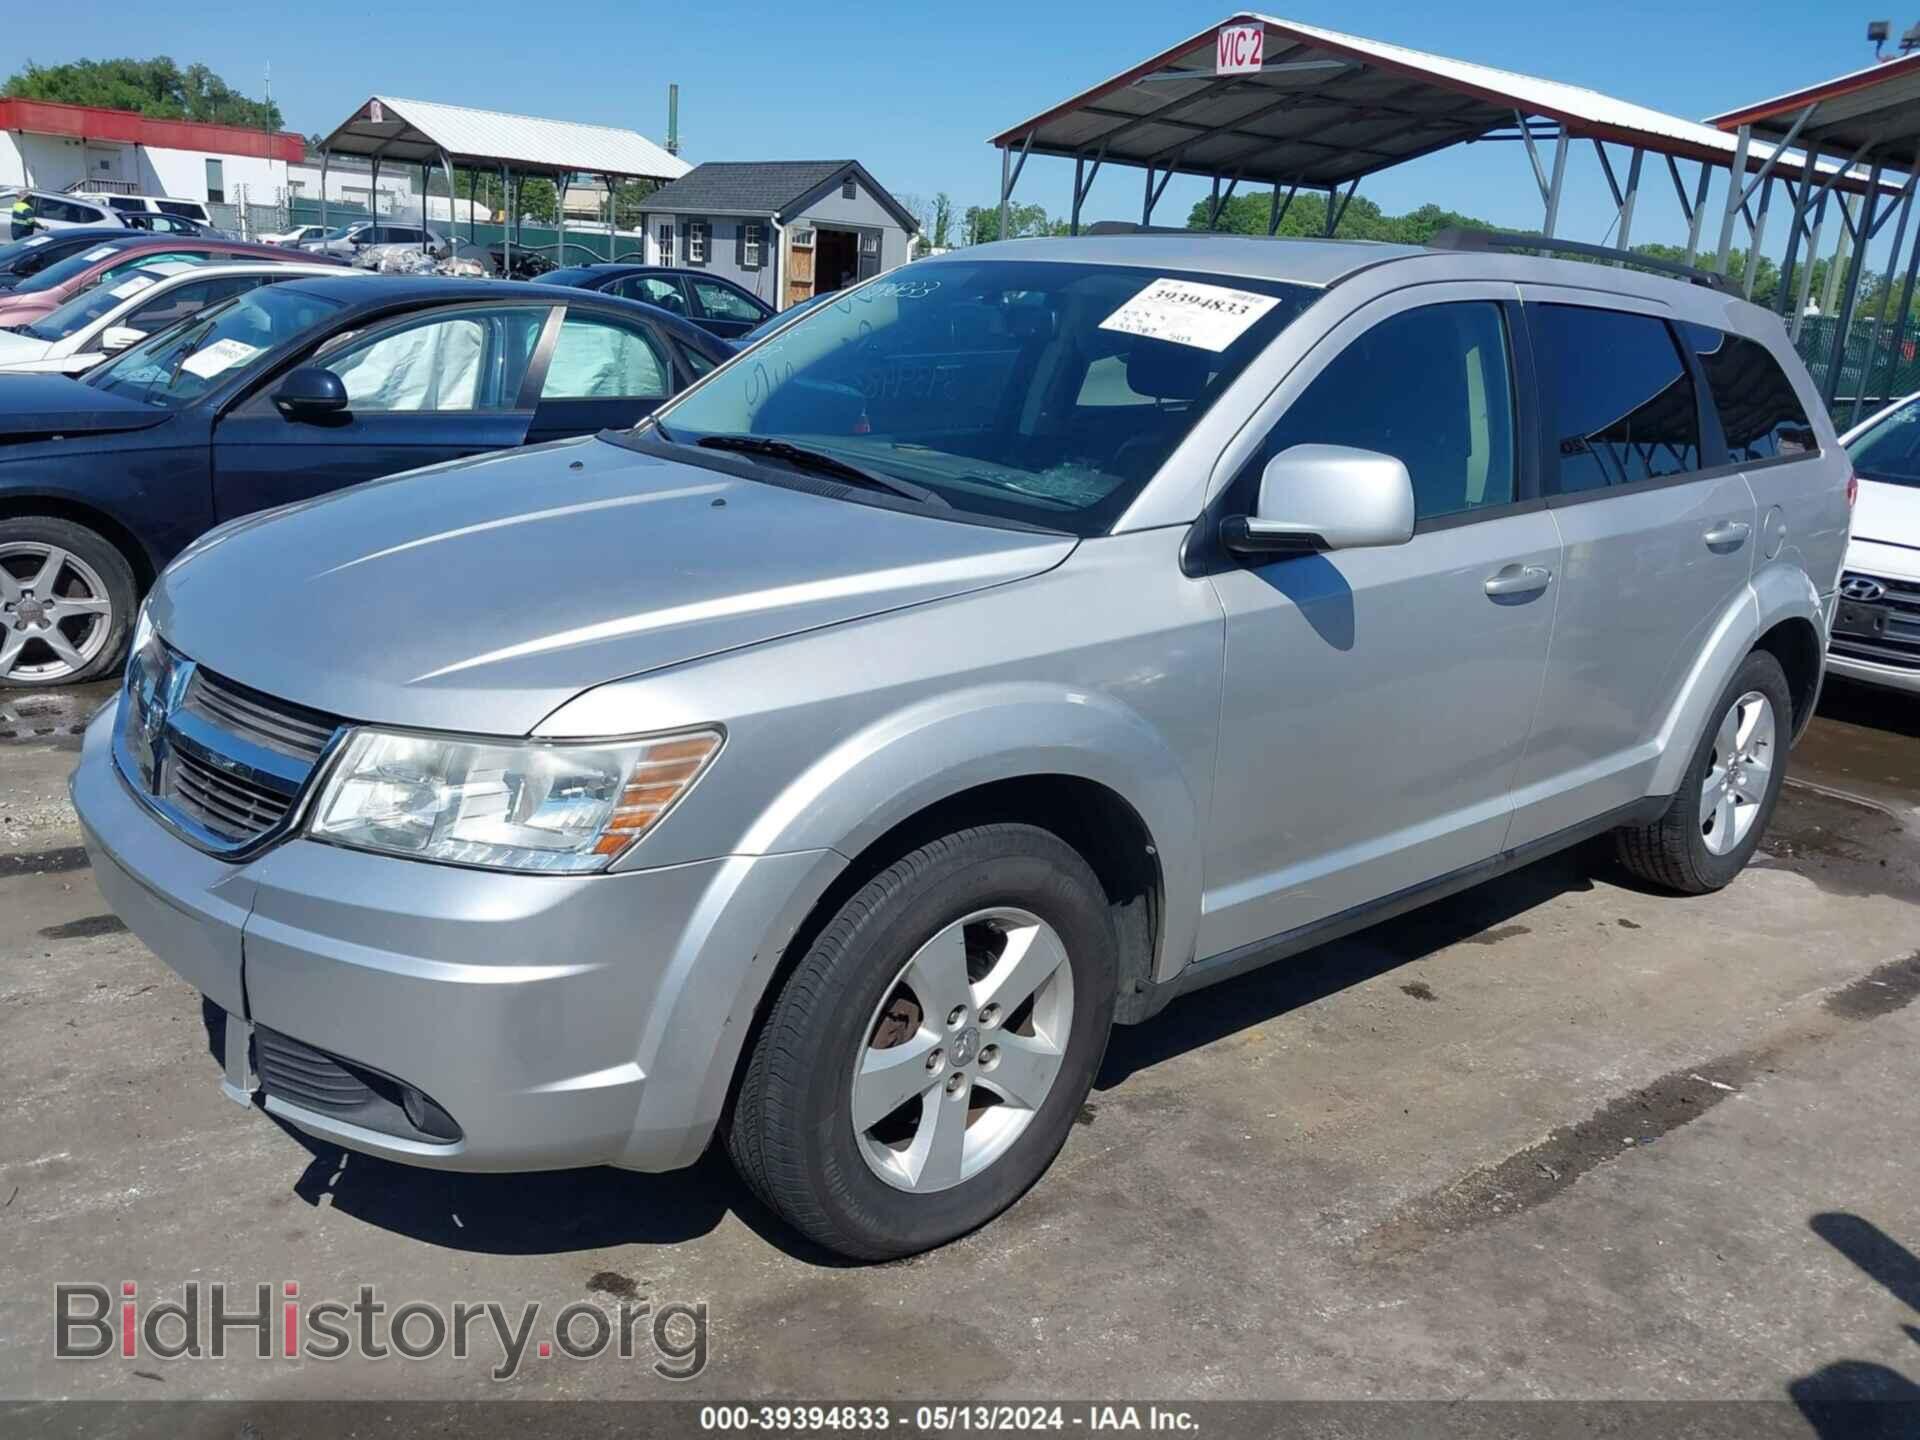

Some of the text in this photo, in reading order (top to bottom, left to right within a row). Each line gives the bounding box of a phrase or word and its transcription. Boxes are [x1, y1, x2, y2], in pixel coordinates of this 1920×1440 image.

[1219, 30, 1262, 67] VIC 2
[1152, 289, 1251, 316] 39394833
